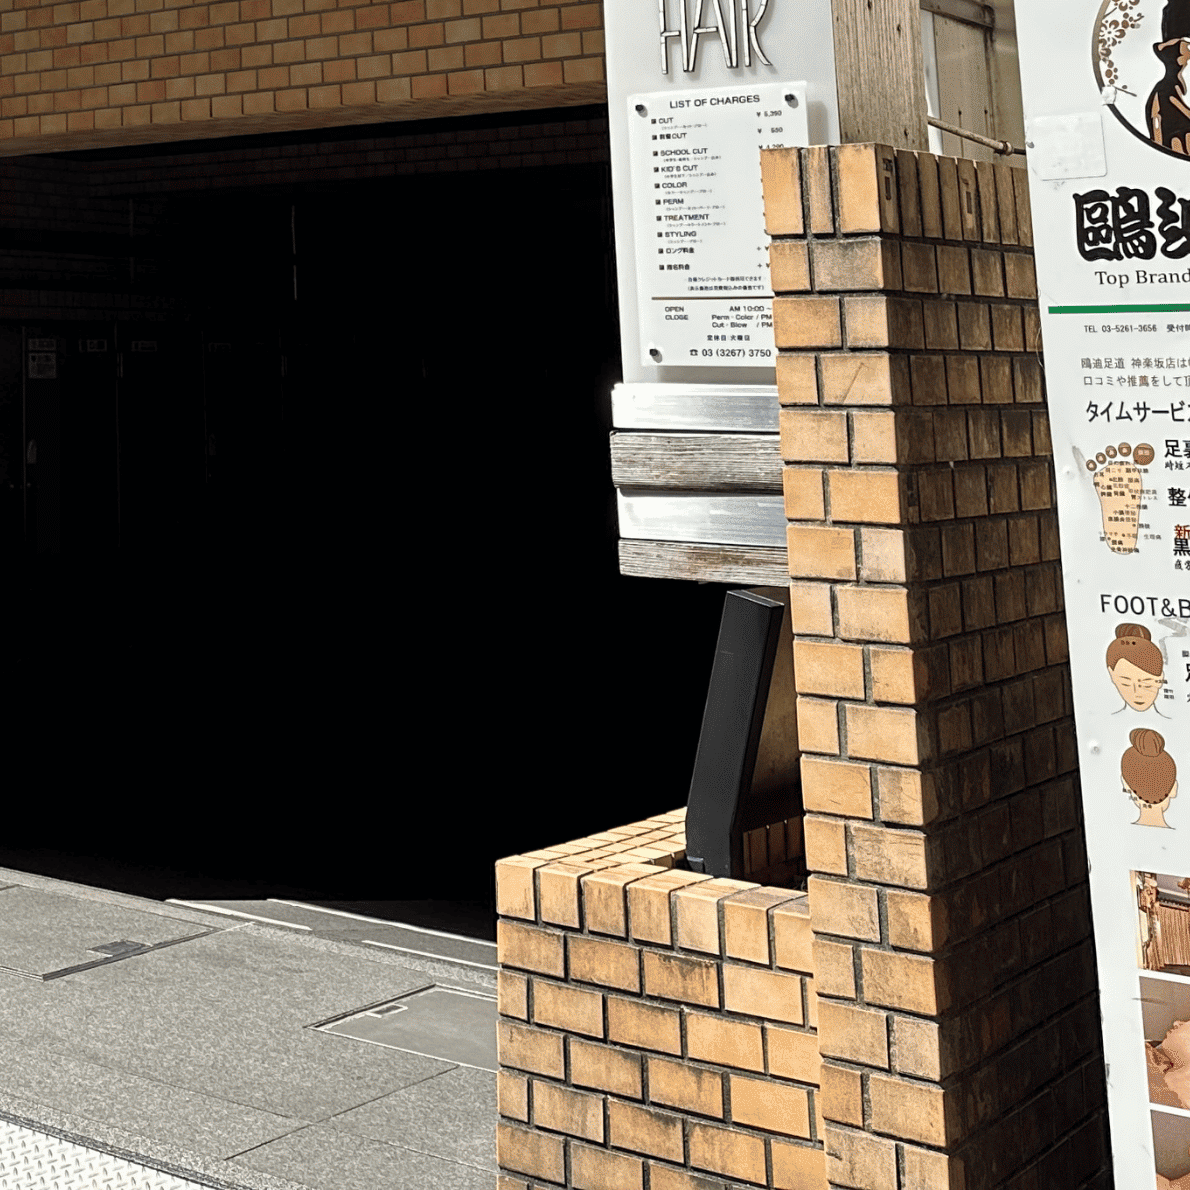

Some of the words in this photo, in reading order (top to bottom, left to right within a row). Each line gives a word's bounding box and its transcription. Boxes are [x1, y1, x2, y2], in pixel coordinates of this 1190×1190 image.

[669, 100, 691, 109] LIST
[694, 97, 708, 107] OF
[710, 94, 760, 106] CHARGES
[658, 117, 674, 125] CUT
[660, 148, 691, 157] SCHOOL
[692, 147, 708, 155] CUT
[682, 164, 699, 172] CUT
[661, 181, 688, 190] COLOR
[663, 197, 684, 206] PERM
[664, 213, 710, 222] TREATMENT
[665, 230, 697, 238] STYLING
[1094, 270, 1130, 288] Top
[1084, 324, 1098, 333] TEL
[701, 348, 714, 357] 03
[715, 348, 746, 358] (3267)
[748, 348, 772, 358] 3750
[1130, 357, 1190, 370] 神楽坂店は
[1086, 399, 1190, 423] タイムサービ
